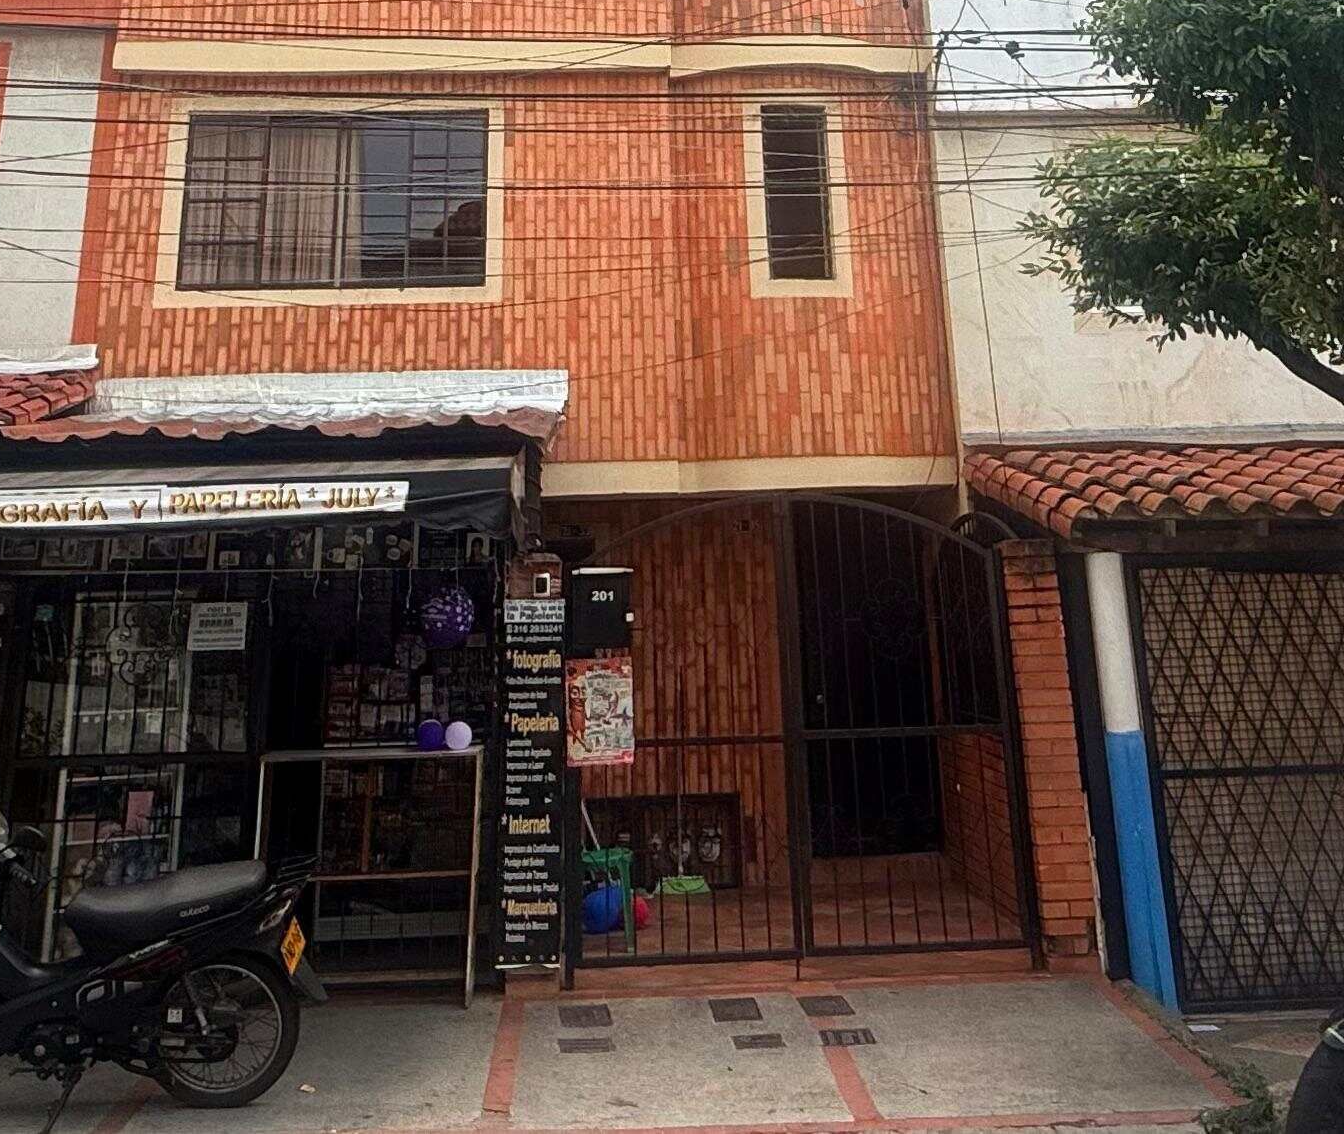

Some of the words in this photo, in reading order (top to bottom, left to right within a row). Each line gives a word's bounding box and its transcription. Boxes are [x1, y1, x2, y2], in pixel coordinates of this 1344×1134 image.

[129, 499, 148, 520] Y
[168, 482, 301, 514] PAPELERÍA
[321, 487, 380, 509] JULY
[591, 590, 615, 602] 201
[508, 814, 552, 835] Internet
